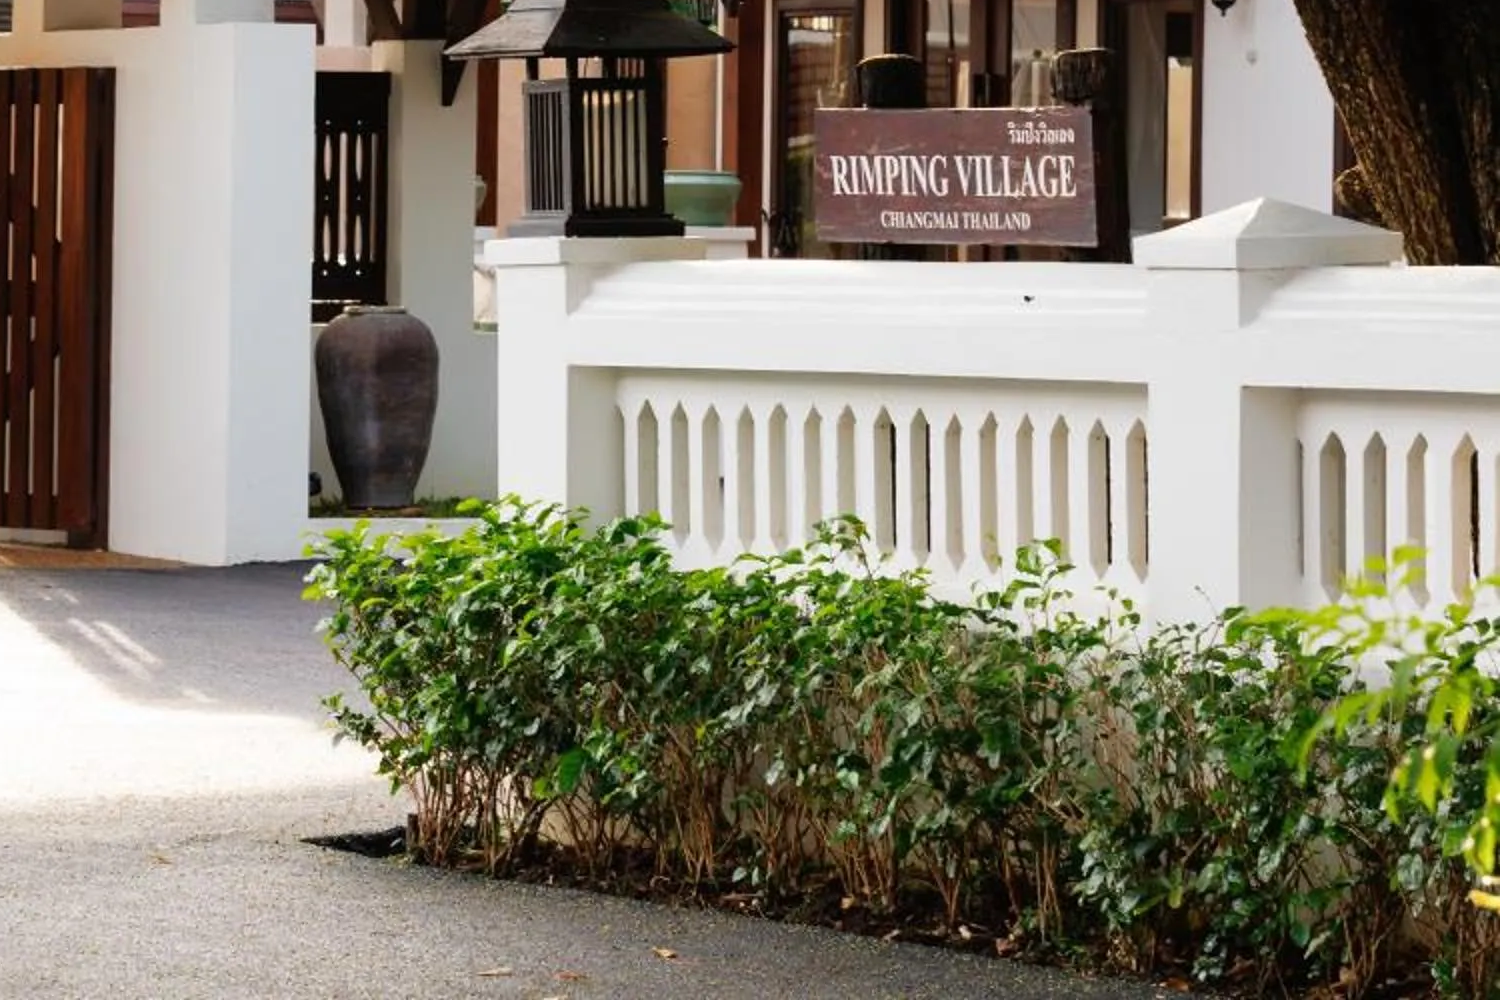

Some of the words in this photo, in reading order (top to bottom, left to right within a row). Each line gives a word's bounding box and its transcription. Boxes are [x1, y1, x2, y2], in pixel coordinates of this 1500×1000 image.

[829, 154, 949, 197] RIMPING
[953, 154, 1077, 199] VILLAGE
[880, 210, 959, 229] CHIANGMAI
[962, 211, 1031, 230] THAILAND
